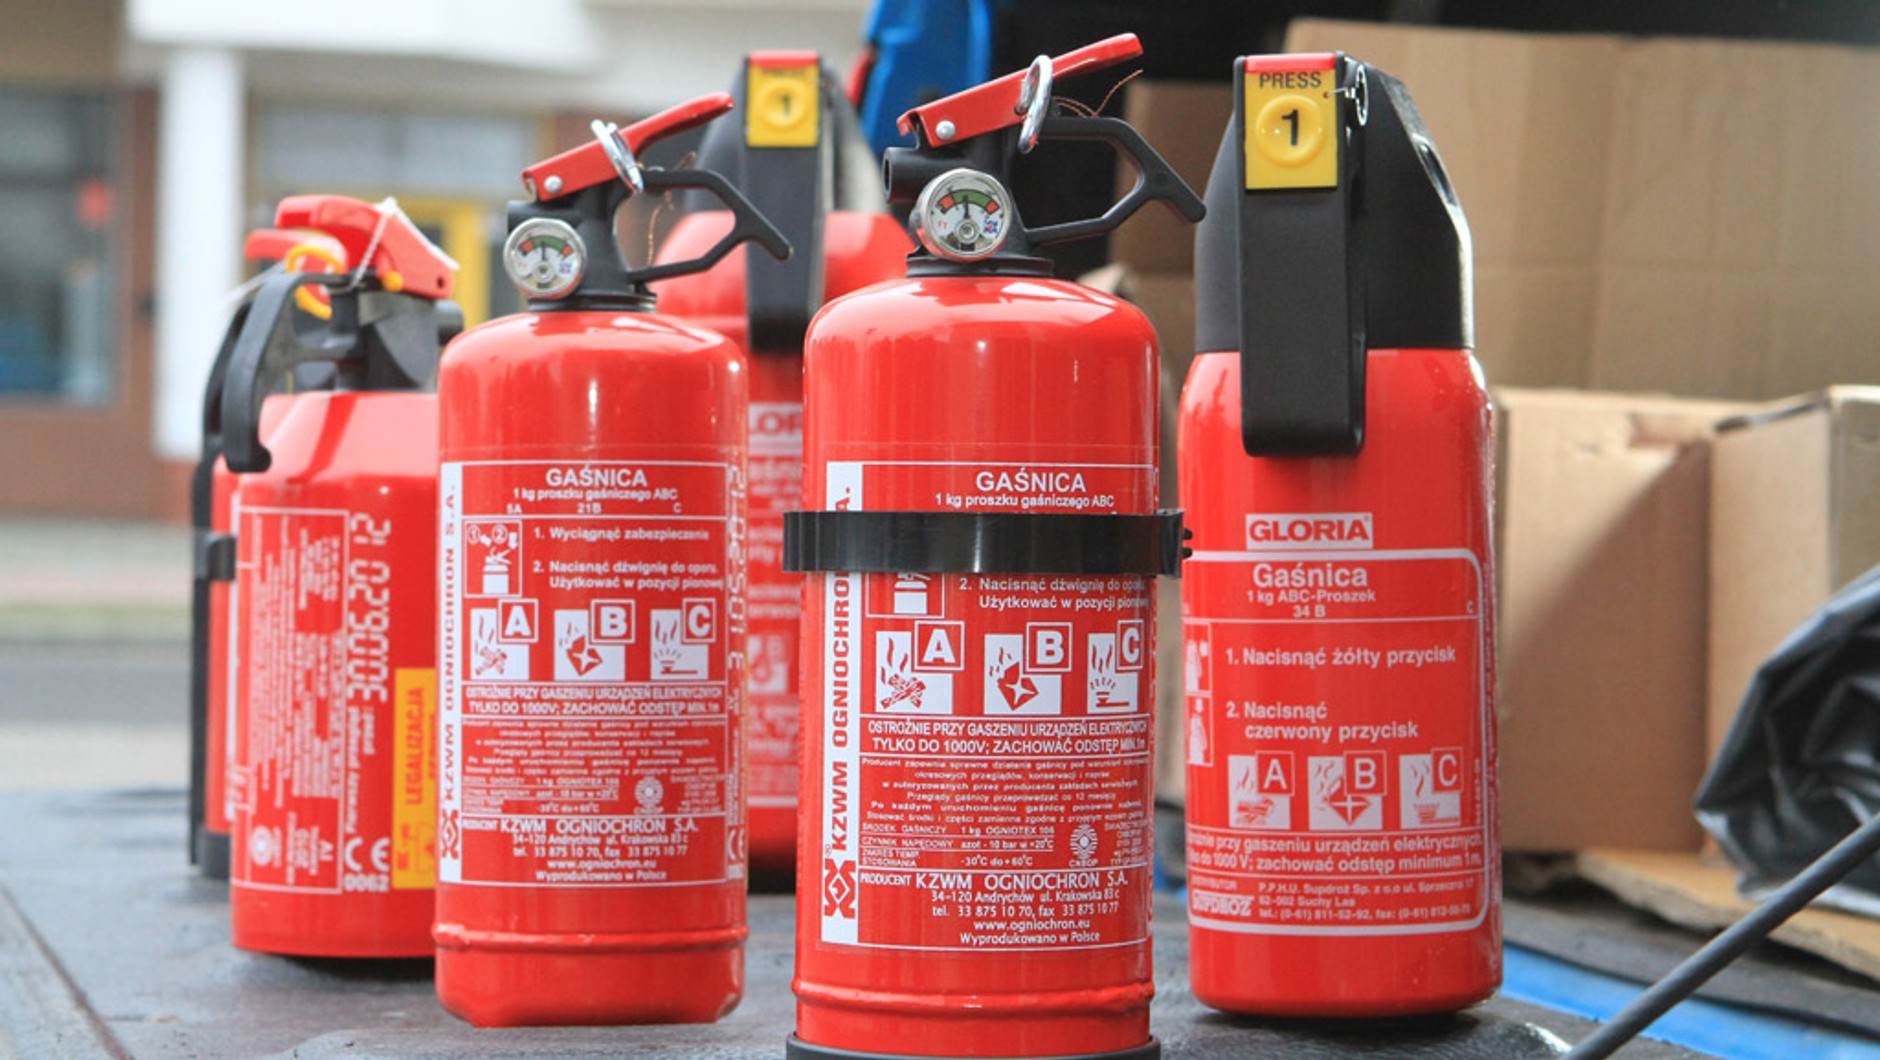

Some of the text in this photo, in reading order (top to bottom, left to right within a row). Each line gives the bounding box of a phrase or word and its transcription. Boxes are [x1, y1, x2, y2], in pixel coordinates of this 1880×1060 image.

[1259, 71, 1322, 89] PRESS
[1281, 108, 1299, 146] 1
[545, 463, 648, 487] GAŚNICA
[976, 467, 1087, 492] GAŚNICA
[514, 488, 519, 499] 1
[522, 488, 535, 501] kg
[538, 488, 583, 501] proszku
[653, 488, 678, 500] ABC
[935, 493, 1115, 509] 1 kg proszku gaśniczego ABC
[507, 503, 682, 514] 5A 21B C
[534, 528, 545, 539] 1.
[550, 527, 621, 542] Wyciągnąć
[1249, 519, 1369, 542] GLORIA
[533, 560, 544, 573] 2.
[550, 560, 609, 576] Nacisnąć
[671, 560, 685, 573] do
[1253, 562, 1368, 588] Gaśnica
[550, 575, 680, 591] Użytkować w pozycji
[959, 577, 1119, 593] 2. Nacisnąć dźwignię do
[979, 595, 1115, 611] Użytkować w pozycji
[1247, 589, 1376, 606] 1 kg ABC-Proszek
[504, 605, 531, 636] A
[600, 606, 628, 637] B
[688, 605, 711, 637] C
[1293, 605, 1326, 617] 34 B
[922, 628, 956, 663] A
[1036, 630, 1064, 665] B
[1122, 628, 1140, 663] C
[1226, 646, 1456, 670] 1. Nacisnąć żółty przycisk
[1226, 701, 1328, 723] 2. Nacisnąć
[868, 718, 931, 735] OSTROŻNIE
[933, 722, 965, 736] PRZY
[968, 722, 1028, 736] GASZENIU
[1030, 719, 1088, 738] URZĄDZEŃ
[1245, 720, 1418, 744] czerwony przycisk
[406, 687, 424, 805] LEGALIZACJA
[872, 737, 915, 752] TYLKO
[919, 739, 940, 752] DO
[944, 740, 989, 755] 1000V;
[993, 737, 1072, 753] ZACHOWAĆ
[1074, 739, 1118, 755] ODSTĘP
[444, 724, 455, 801] KZWM
[1438, 755, 1457, 787] C
[1263, 758, 1287, 790] A
[1354, 758, 1377, 790] B
[832, 761, 849, 852] KZWM
[501, 818, 699, 834] KZWM OGNIOCHRON S.A.
[1216, 837, 1240, 852] przy
[1243, 836, 1311, 855] gaszeniu
[1315, 835, 1390, 856] urządzeń
[1240, 854, 1253, 871] V;
[1257, 855, 1334, 872] zachować
[1338, 856, 1395, 875] odstęp
[1399, 853, 1462, 870] minimum
[916, 872, 972, 890] KZWM
[984, 872, 1099, 891] OGNIOCHRON
[1107, 870, 1128, 887] S.A.
[931, 890, 973, 903] 34-120
[975, 890, 1034, 906] Andrychów
[1040, 890, 1053, 902] ul.
[1335, 897, 1356, 907] Las
[932, 905, 950, 916] tel.
[957, 905, 972, 917] 33
[975, 905, 997, 917] 875
[1002, 905, 1015, 917] 10
[1019, 905, 1036, 919] 70,
[1038, 904, 1055, 917] fax
[1062, 904, 1074, 916] 33
[1078, 902, 1095, 915] 875
[1097, 902, 1107, 914] 10
[973, 919, 1090, 933] www.ogniochron.eu
[960, 931, 1100, 947] Wyprodukowano w Polsce
